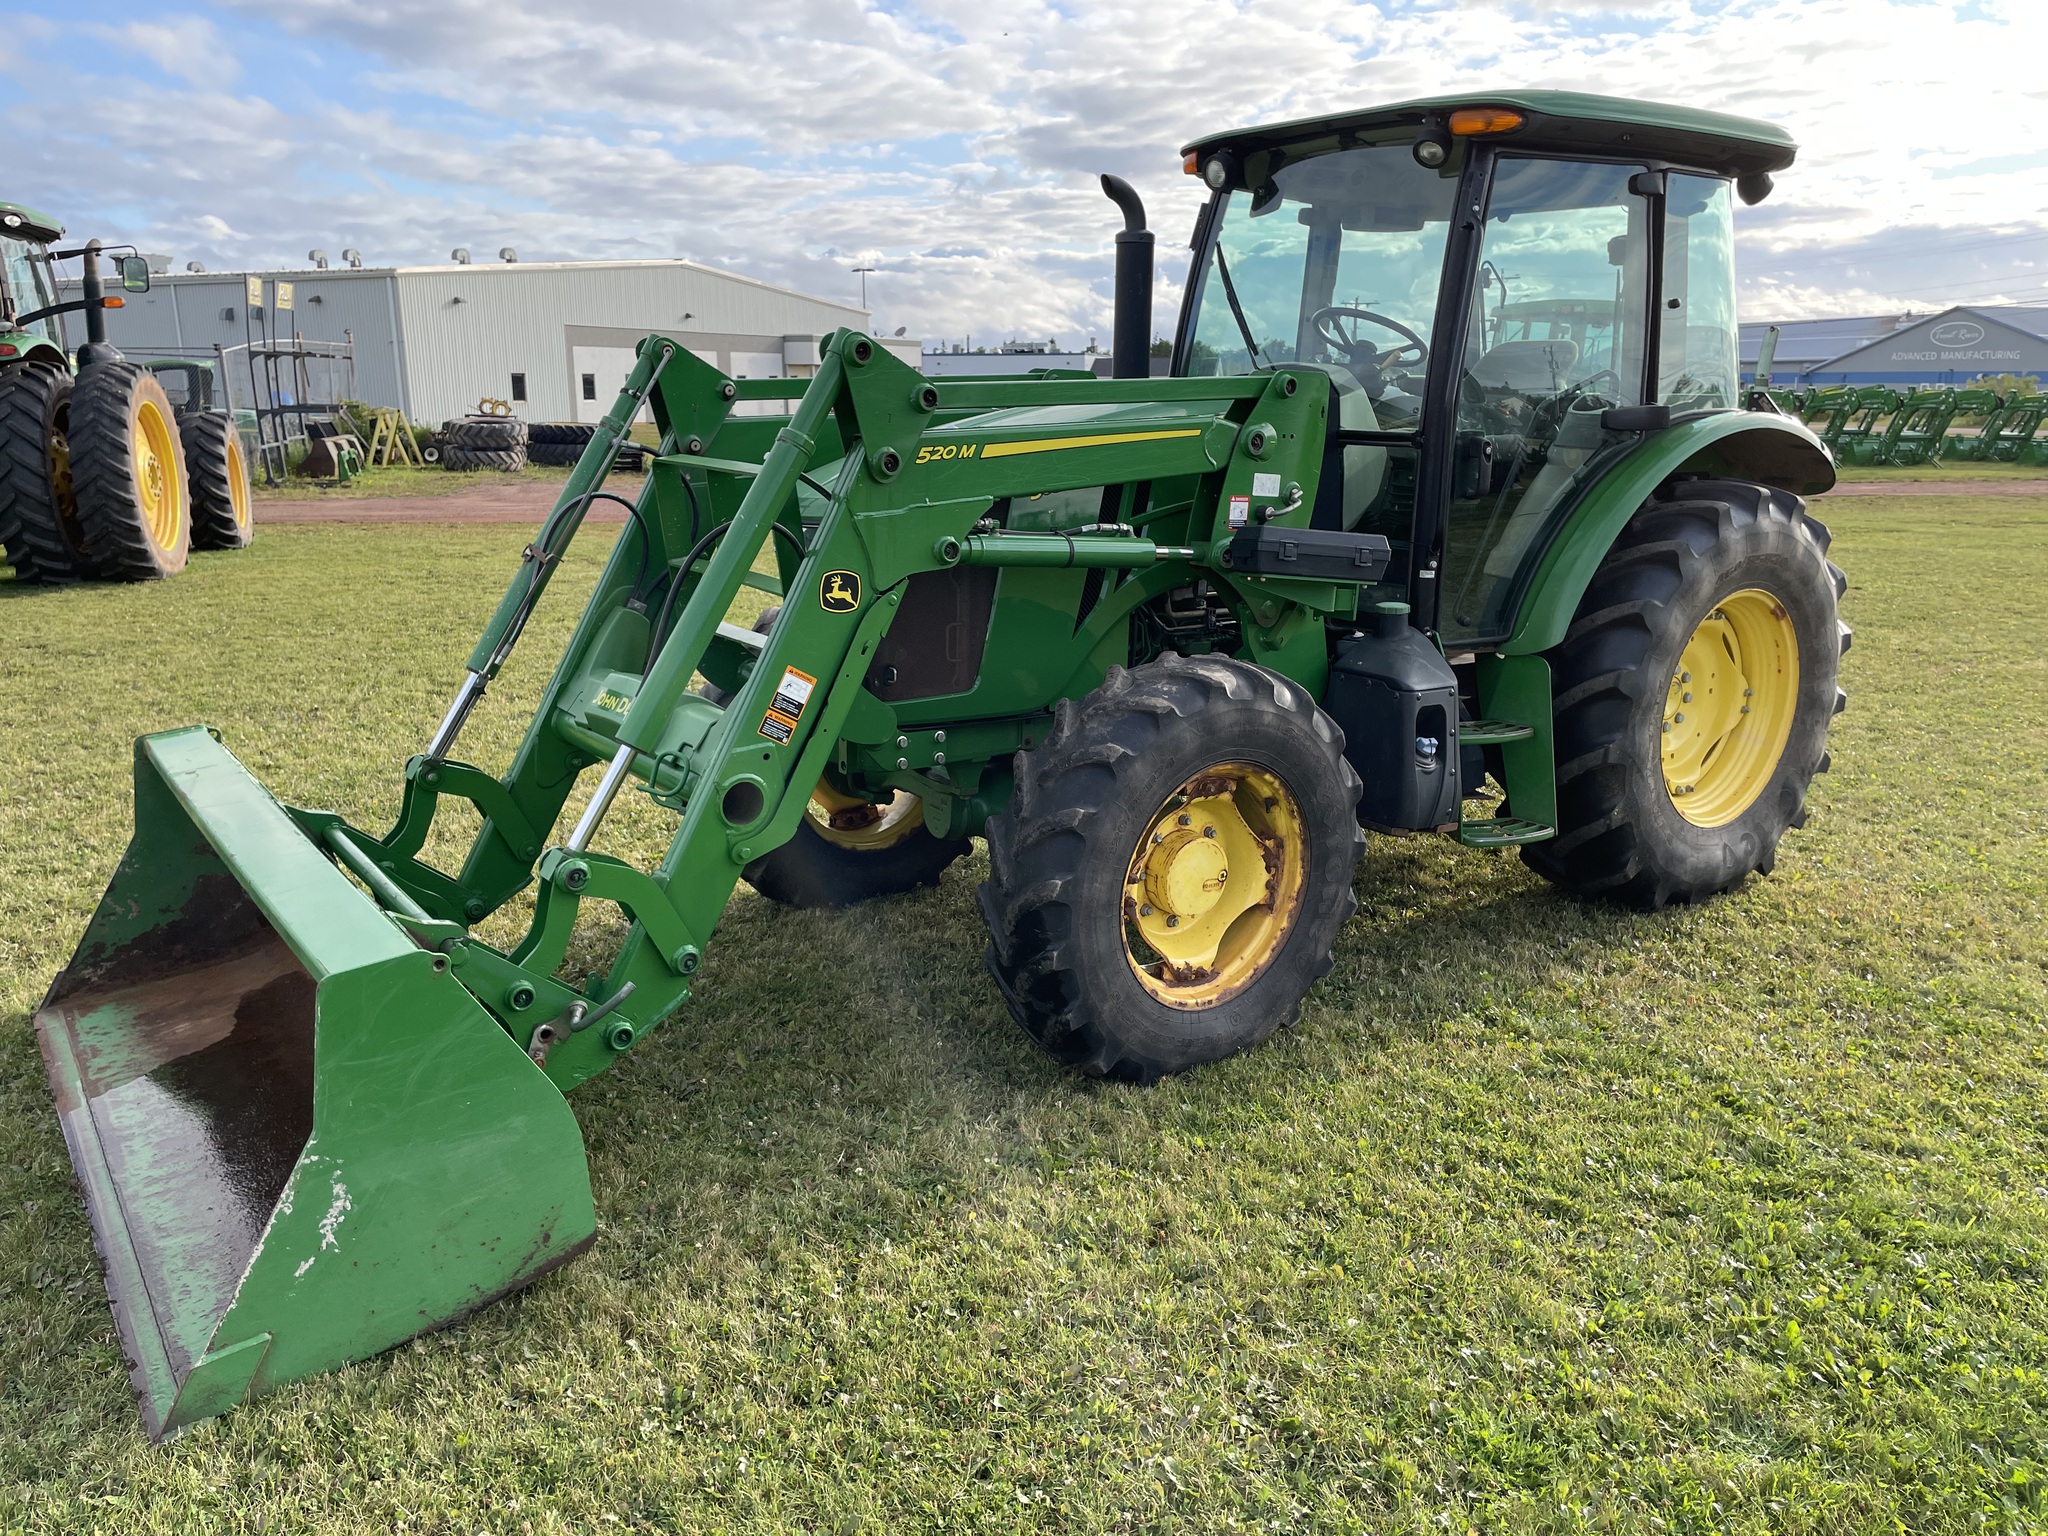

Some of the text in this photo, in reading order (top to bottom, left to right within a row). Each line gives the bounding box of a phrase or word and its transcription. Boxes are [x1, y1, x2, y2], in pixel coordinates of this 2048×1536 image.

[1891, 350, 2021, 361] ADVANCED MANUFACTURING
[915, 443, 977, 464] 520 M
[592, 689, 619, 710] JOHN
